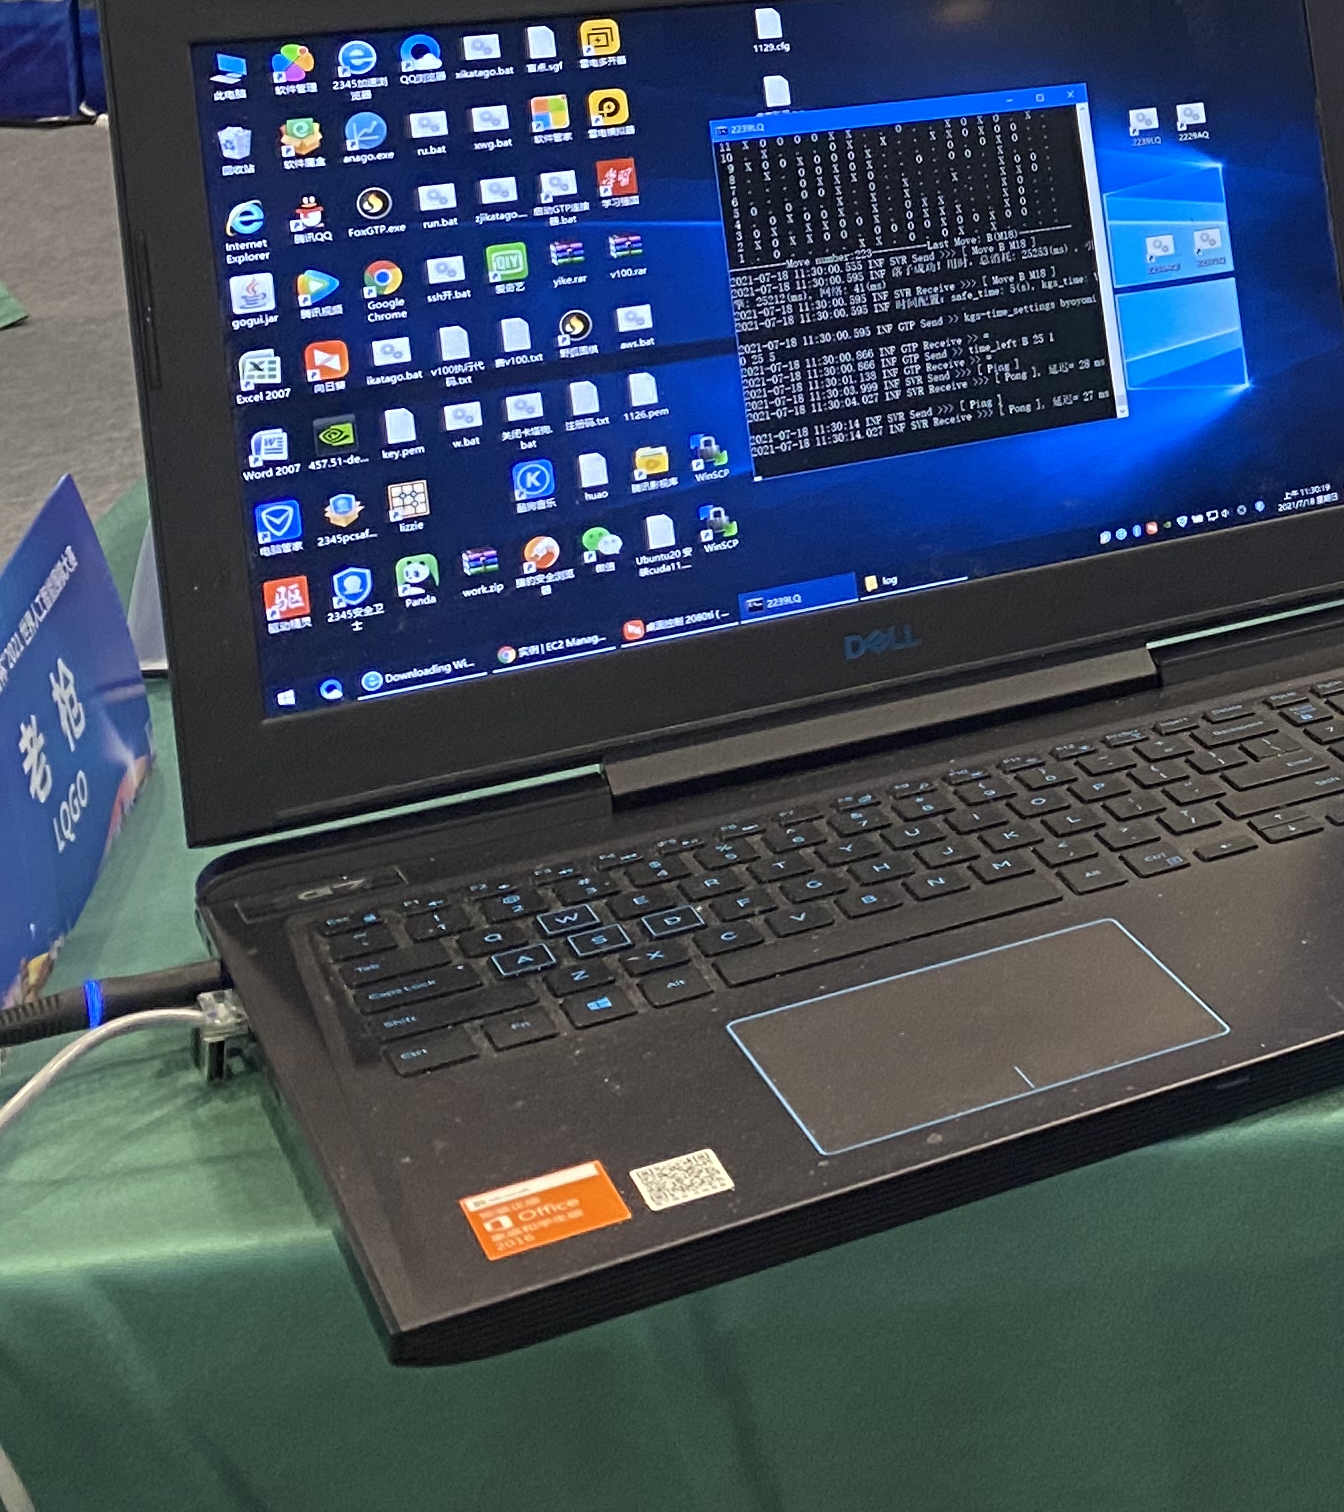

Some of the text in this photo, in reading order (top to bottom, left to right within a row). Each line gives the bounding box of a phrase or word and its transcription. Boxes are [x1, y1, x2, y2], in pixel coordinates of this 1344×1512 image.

[423, 218, 458, 229] run.bat
[348, 224, 406, 238] FoxGTP.exe
[226, 240, 267, 252] Internet
[227, 252, 270, 265] Explorer
[368, 297, 405, 310] Google
[231, 314, 279, 330] gogui.jar
[367, 310, 408, 323] Chrome
[236, 388, 292, 405] Excel 2007
[243, 463, 301, 482] Word 2007
[695, 469, 730, 483] WinSCP
[704, 539, 739, 553] WinSCP
[462, 583, 504, 598] work.zip
[405, 594, 437, 608] Panda
[843, 624, 922, 661] DELL
[518, 1197, 580, 1223] Office
